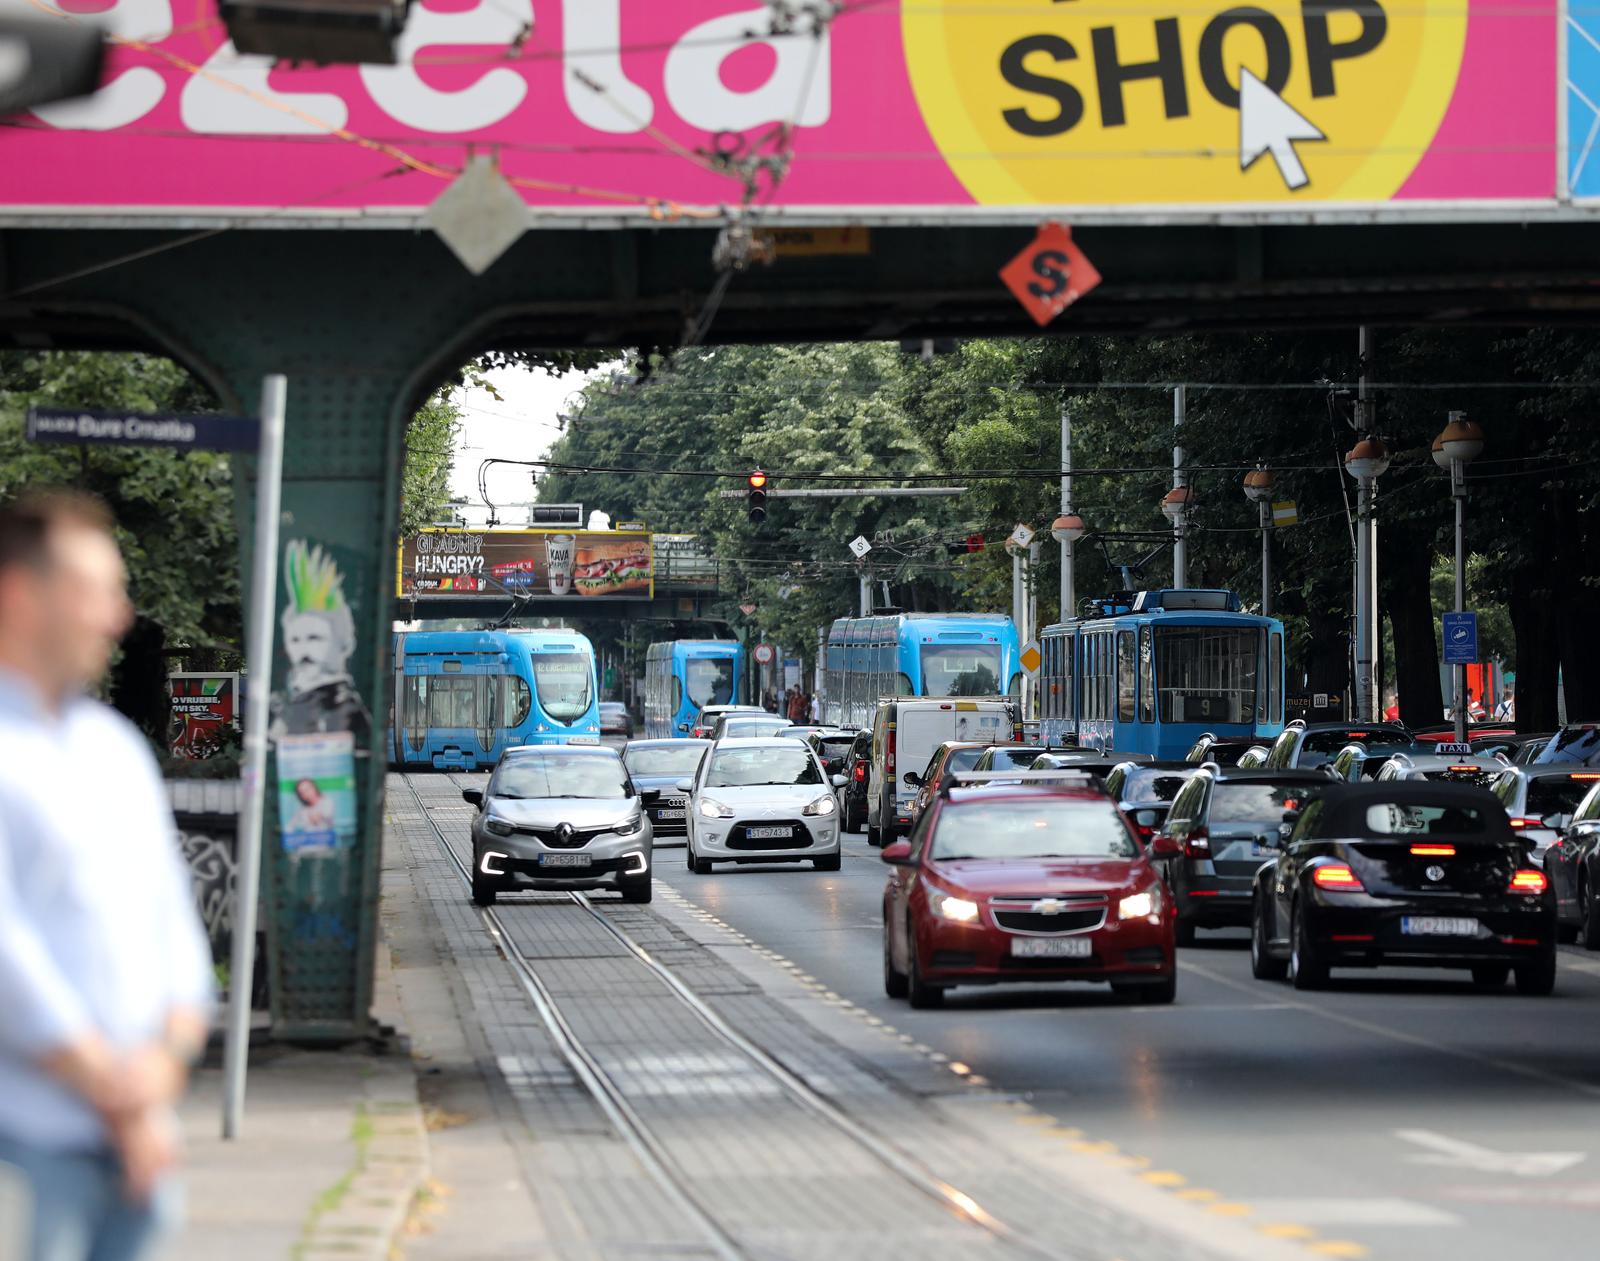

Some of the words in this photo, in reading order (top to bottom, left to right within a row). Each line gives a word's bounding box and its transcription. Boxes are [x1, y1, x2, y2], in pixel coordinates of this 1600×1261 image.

[999, 0, 1388, 138] SHOP
[1028, 250, 1070, 299] S
[857, 542, 864, 551] S
[550, 549, 569, 561] KAVA
[415, 555, 485, 573] HUNGRY?
[1201, 699, 1210, 716] 9
[1286, 697, 1311, 708] muzej
[1441, 744, 1467, 752] TAXI
